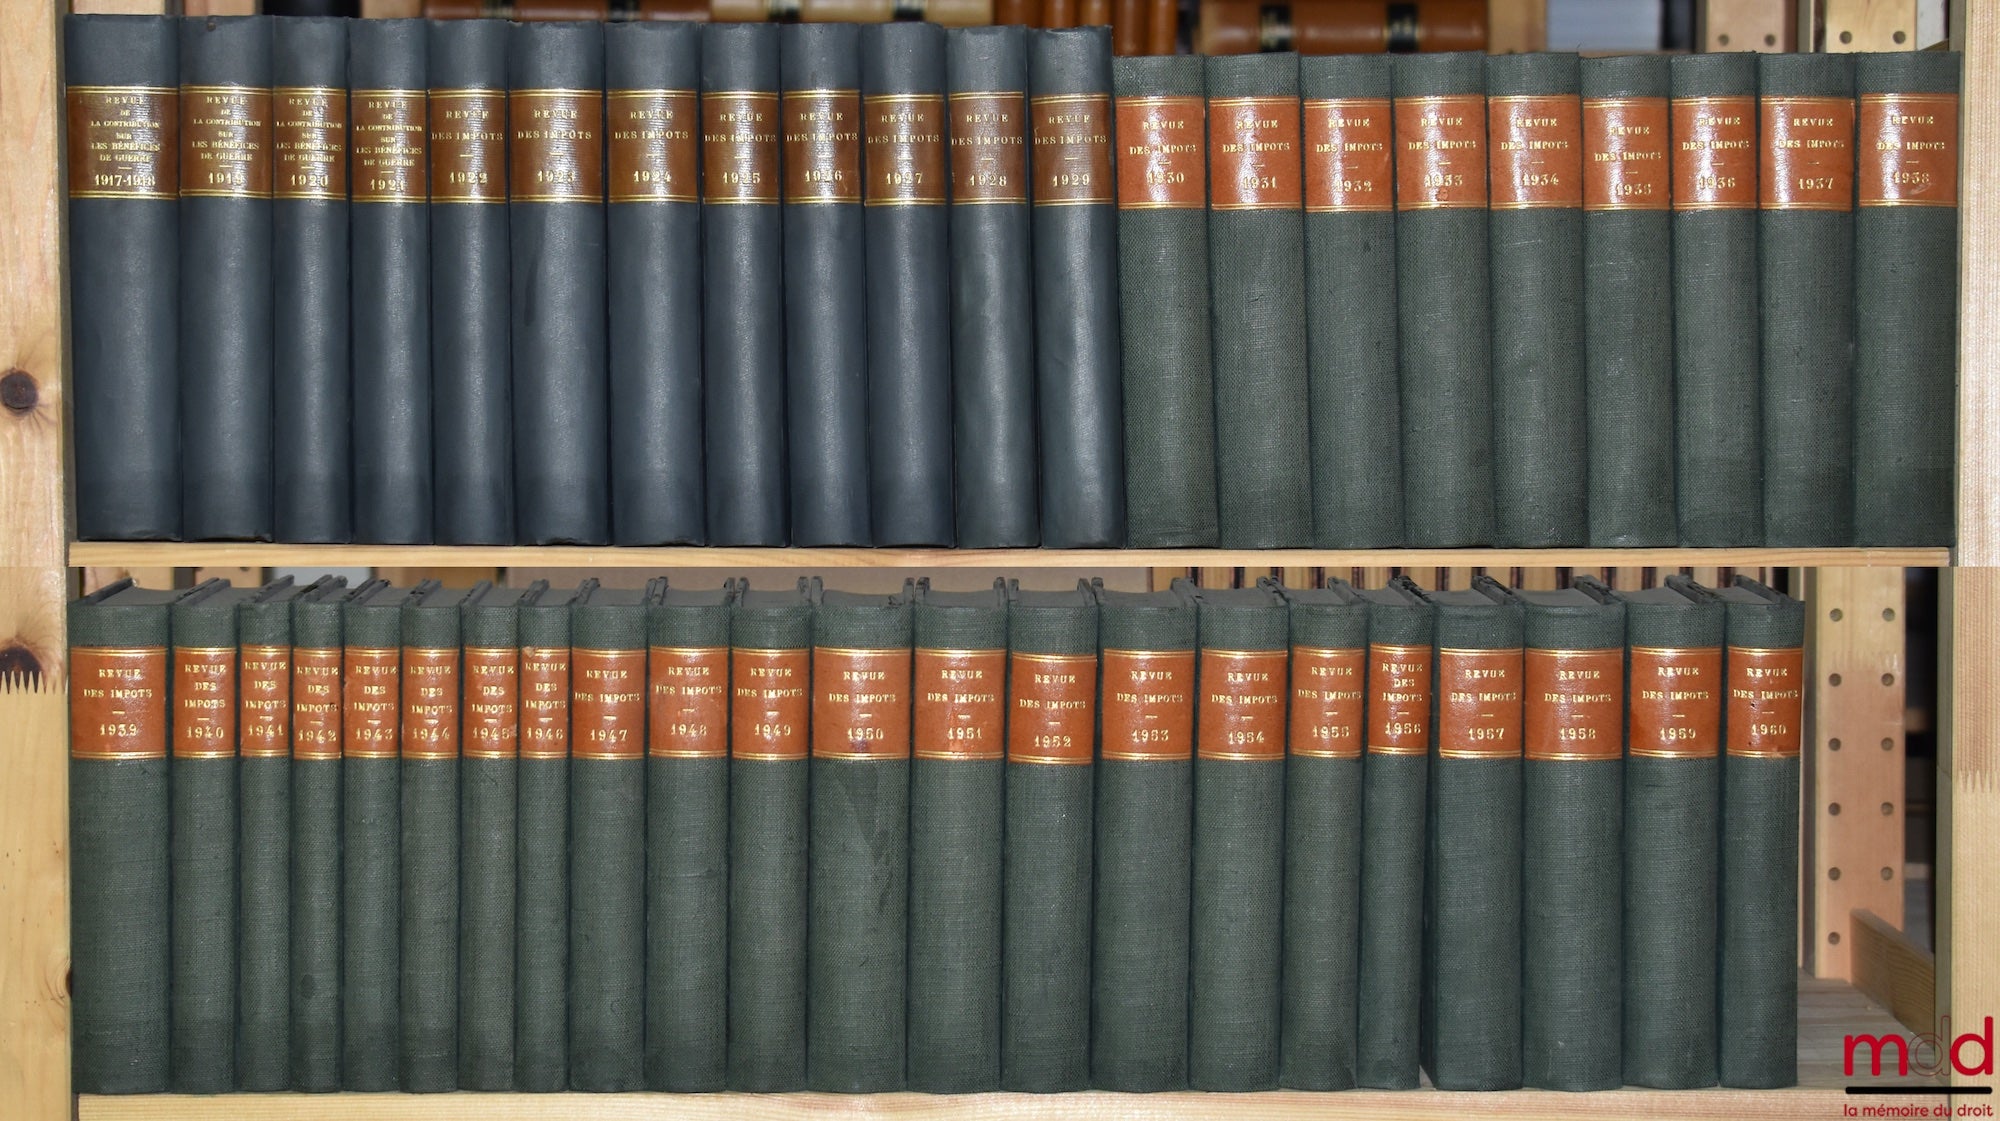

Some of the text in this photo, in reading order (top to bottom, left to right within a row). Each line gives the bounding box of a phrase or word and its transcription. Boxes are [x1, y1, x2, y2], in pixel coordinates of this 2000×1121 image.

[967, 114, 1008, 122] REVUE
[1794, 118, 1833, 126] REVUE
[977, 136, 1023, 145] IMPOTS
[1060, 136, 1107, 144] IMPOTS
[1223, 144, 1243, 152] DES
[1317, 144, 1337, 152] DES
[450, 172, 488, 184] 1922
[970, 175, 1007, 186] 1928
[1053, 174, 1090, 186] 1929
[1523, 174, 1558, 186] 1934
[1893, 172, 1929, 184] 1938
[1799, 178, 1833, 189] 1937
[195, 682, 216, 691] DES
[254, 681, 276, 689] DES
[536, 683, 557, 692] DES
[1394, 679, 1415, 687] DES
[84, 689, 104, 697] DES
[308, 685, 329, 693] DES
[364, 686, 385, 694] DES
[421, 688, 442, 696] DES
[483, 686, 505, 696] DES
[656, 685, 676, 694] DES
[737, 689, 757, 697] DES
[1298, 689, 1317, 698] DES
[575, 693, 594, 701] DES
[829, 694, 849, 702] DES
[928, 693, 948, 702] DES
[1117, 693, 1137, 702] DES
[1452, 693, 1471, 702] DES
[1545, 693, 1565, 702] DES
[1642, 691, 1663, 699] DES
[1734, 690, 1754, 698] DES
[1212, 695, 1232, 703] DES
[1019, 700, 1040, 708] DES
[100, 724, 138, 736] 1939
[187, 727, 224, 739] 1940
[249, 725, 283, 736] 1941
[755, 724, 791, 736] 1949
[1385, 723, 1421, 734] 1956
[299, 730, 337, 742] 1942
[356, 728, 393, 741] 1943
[527, 728, 563, 739] 1946
[591, 730, 628, 742] 1947
[947, 728, 982, 740] 1951
[1560, 728, 1596, 739] 1958
[1035, 736, 1071, 748] 1952
